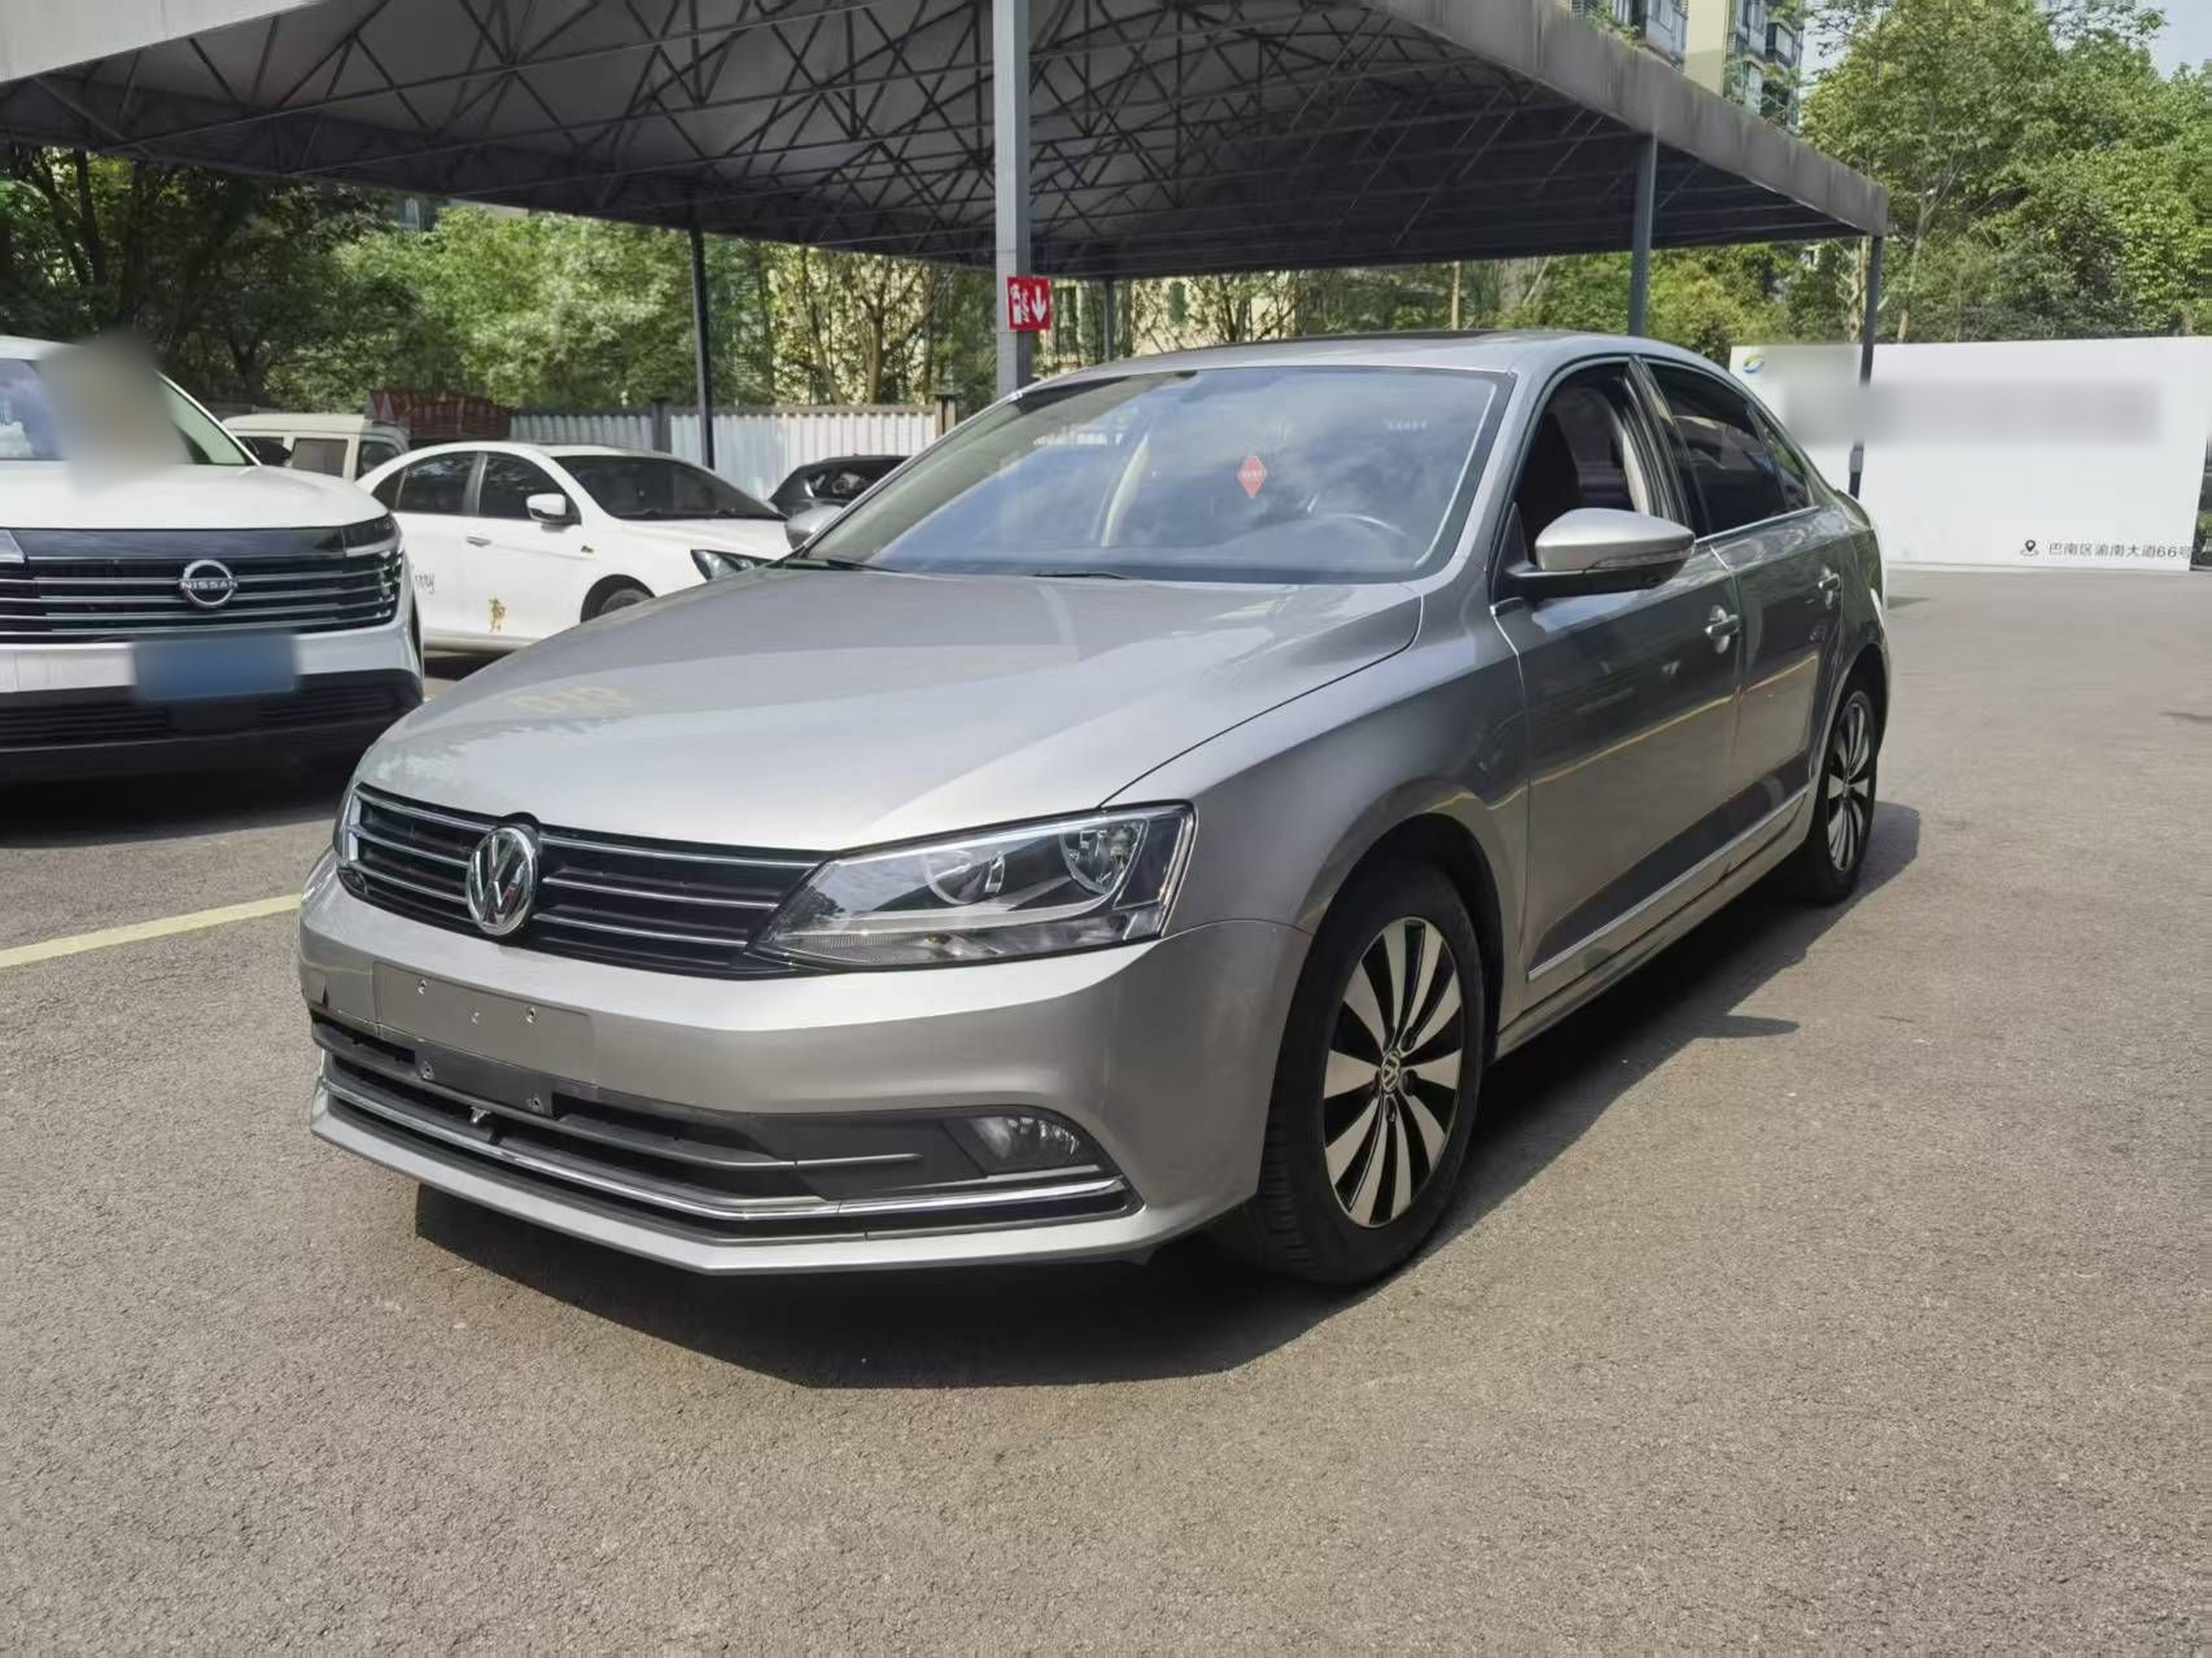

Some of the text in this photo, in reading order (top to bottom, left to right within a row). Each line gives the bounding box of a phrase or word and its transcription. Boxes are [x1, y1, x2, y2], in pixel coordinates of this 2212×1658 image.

[2048, 542, 2191, 559] 巴南区渝南大道66号
[180, 580, 238, 590] NISSAN
